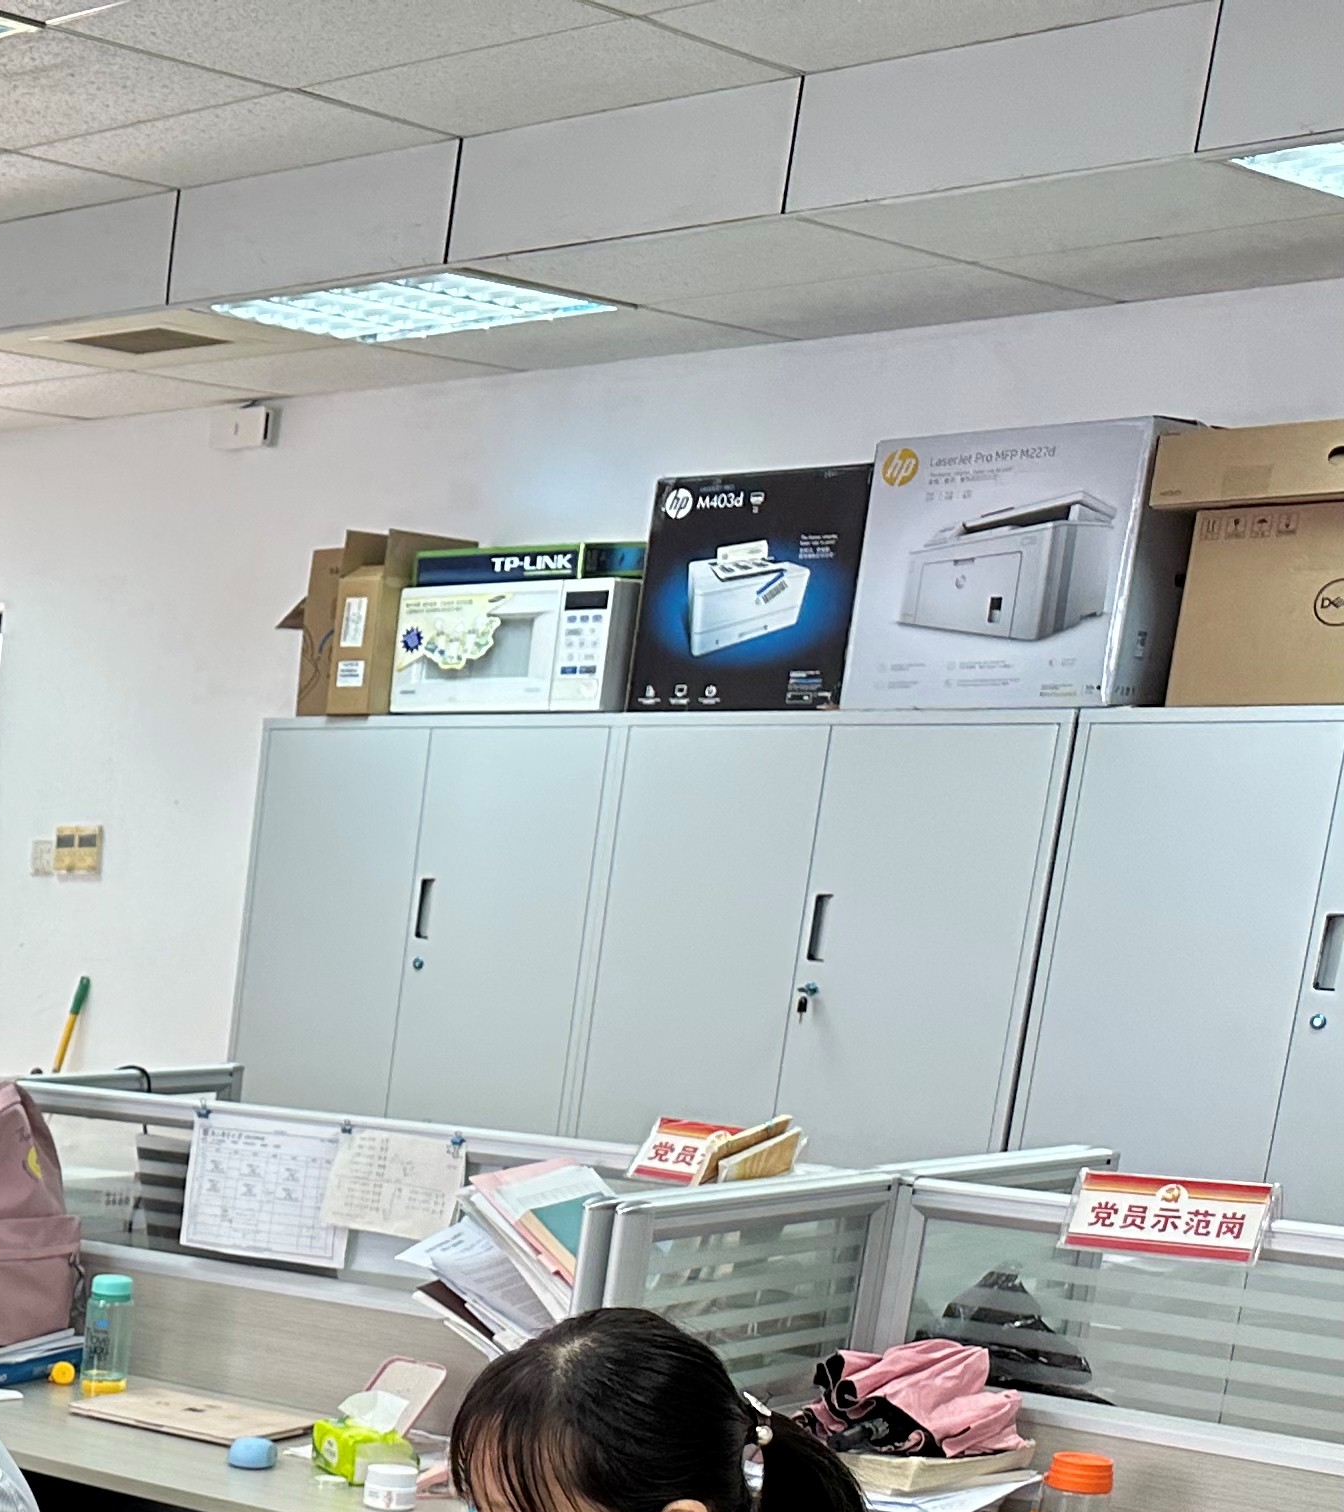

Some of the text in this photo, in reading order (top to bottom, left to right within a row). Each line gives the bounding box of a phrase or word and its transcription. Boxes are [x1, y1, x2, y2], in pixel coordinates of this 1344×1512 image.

[884, 448, 917, 487] hp
[929, 451, 973, 467] LaserJet
[974, 451, 993, 464] Pro
[995, 449, 1019, 462] MFP
[667, 488, 693, 520] hp
[696, 491, 745, 510] M403d
[491, 553, 572, 573] TP-LINK
[1087, 1201, 1246, 1240] 党员示范岗
